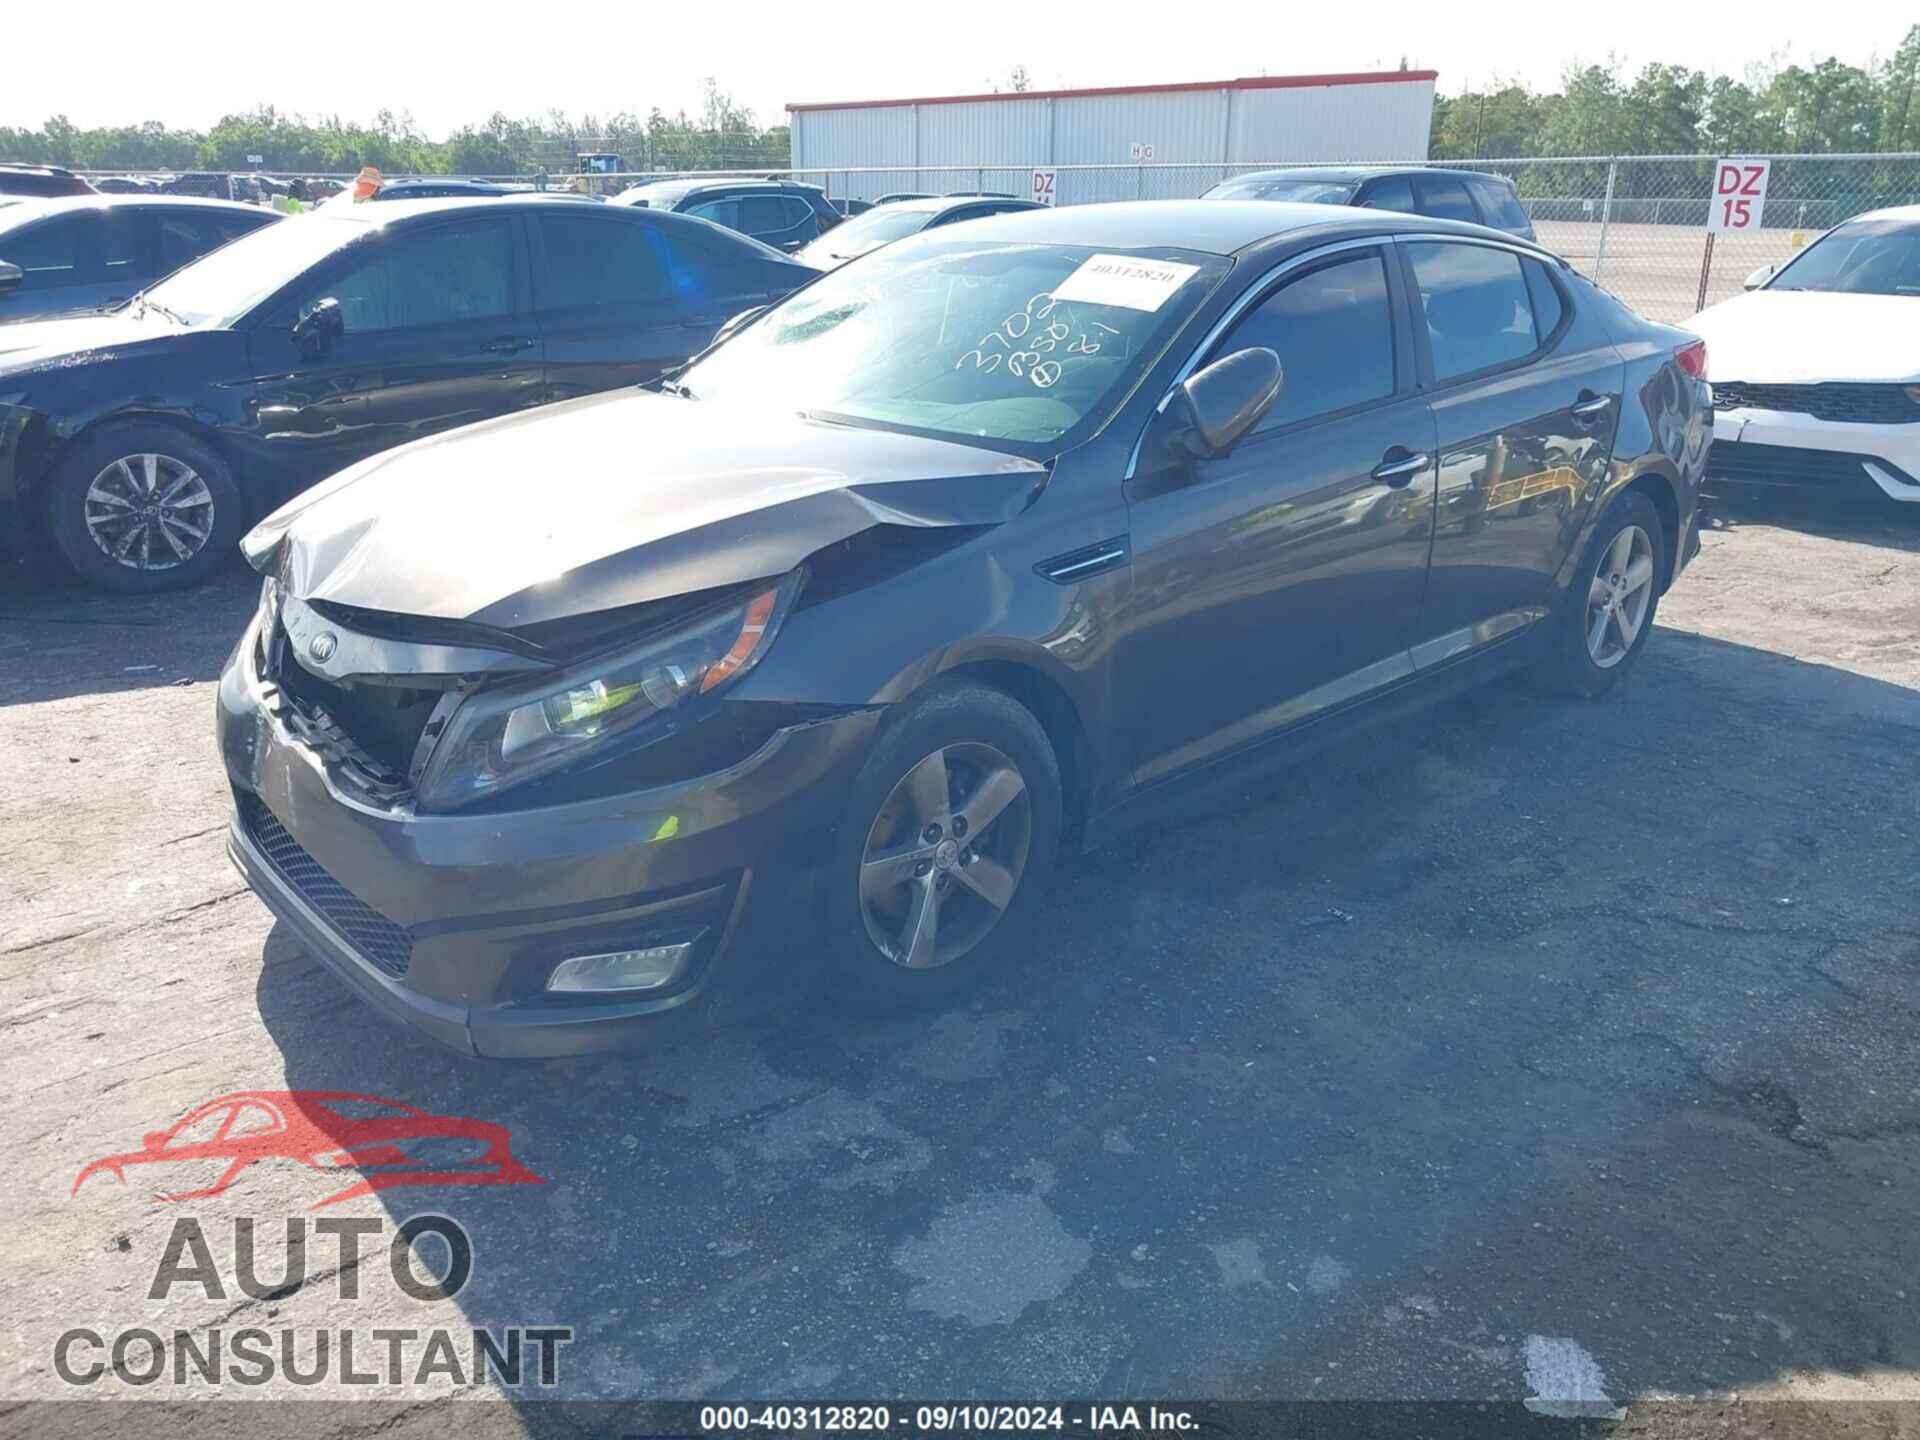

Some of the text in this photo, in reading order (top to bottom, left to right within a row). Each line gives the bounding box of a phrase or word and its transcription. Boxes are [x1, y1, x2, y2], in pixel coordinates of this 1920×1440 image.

[1034, 173, 1055, 193] DZ
[1718, 166, 1765, 195] DZ
[1723, 199, 1751, 228] 15
